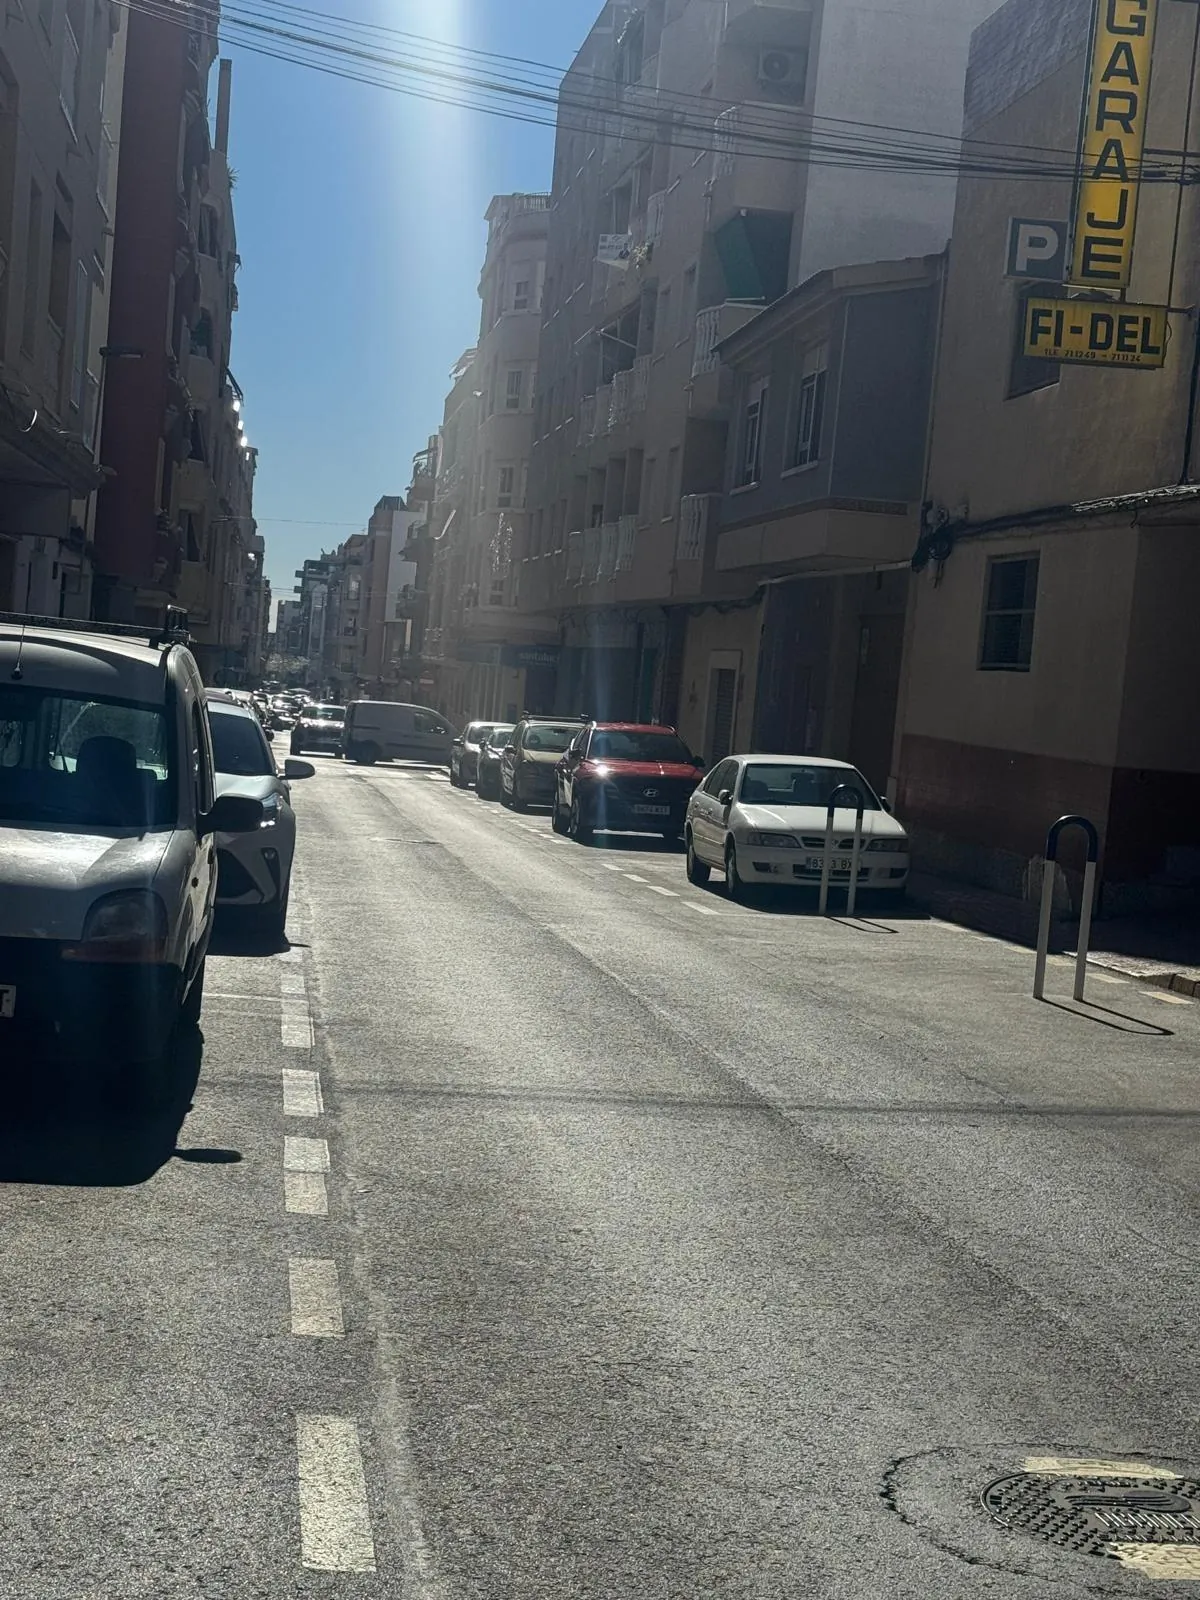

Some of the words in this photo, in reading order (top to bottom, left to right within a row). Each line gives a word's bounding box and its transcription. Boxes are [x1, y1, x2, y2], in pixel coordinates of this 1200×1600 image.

[1081, 0, 1147, 280] GARAJE
[1015, 223, 1058, 272] P
[1030, 308, 1160, 355] FI-DEL
